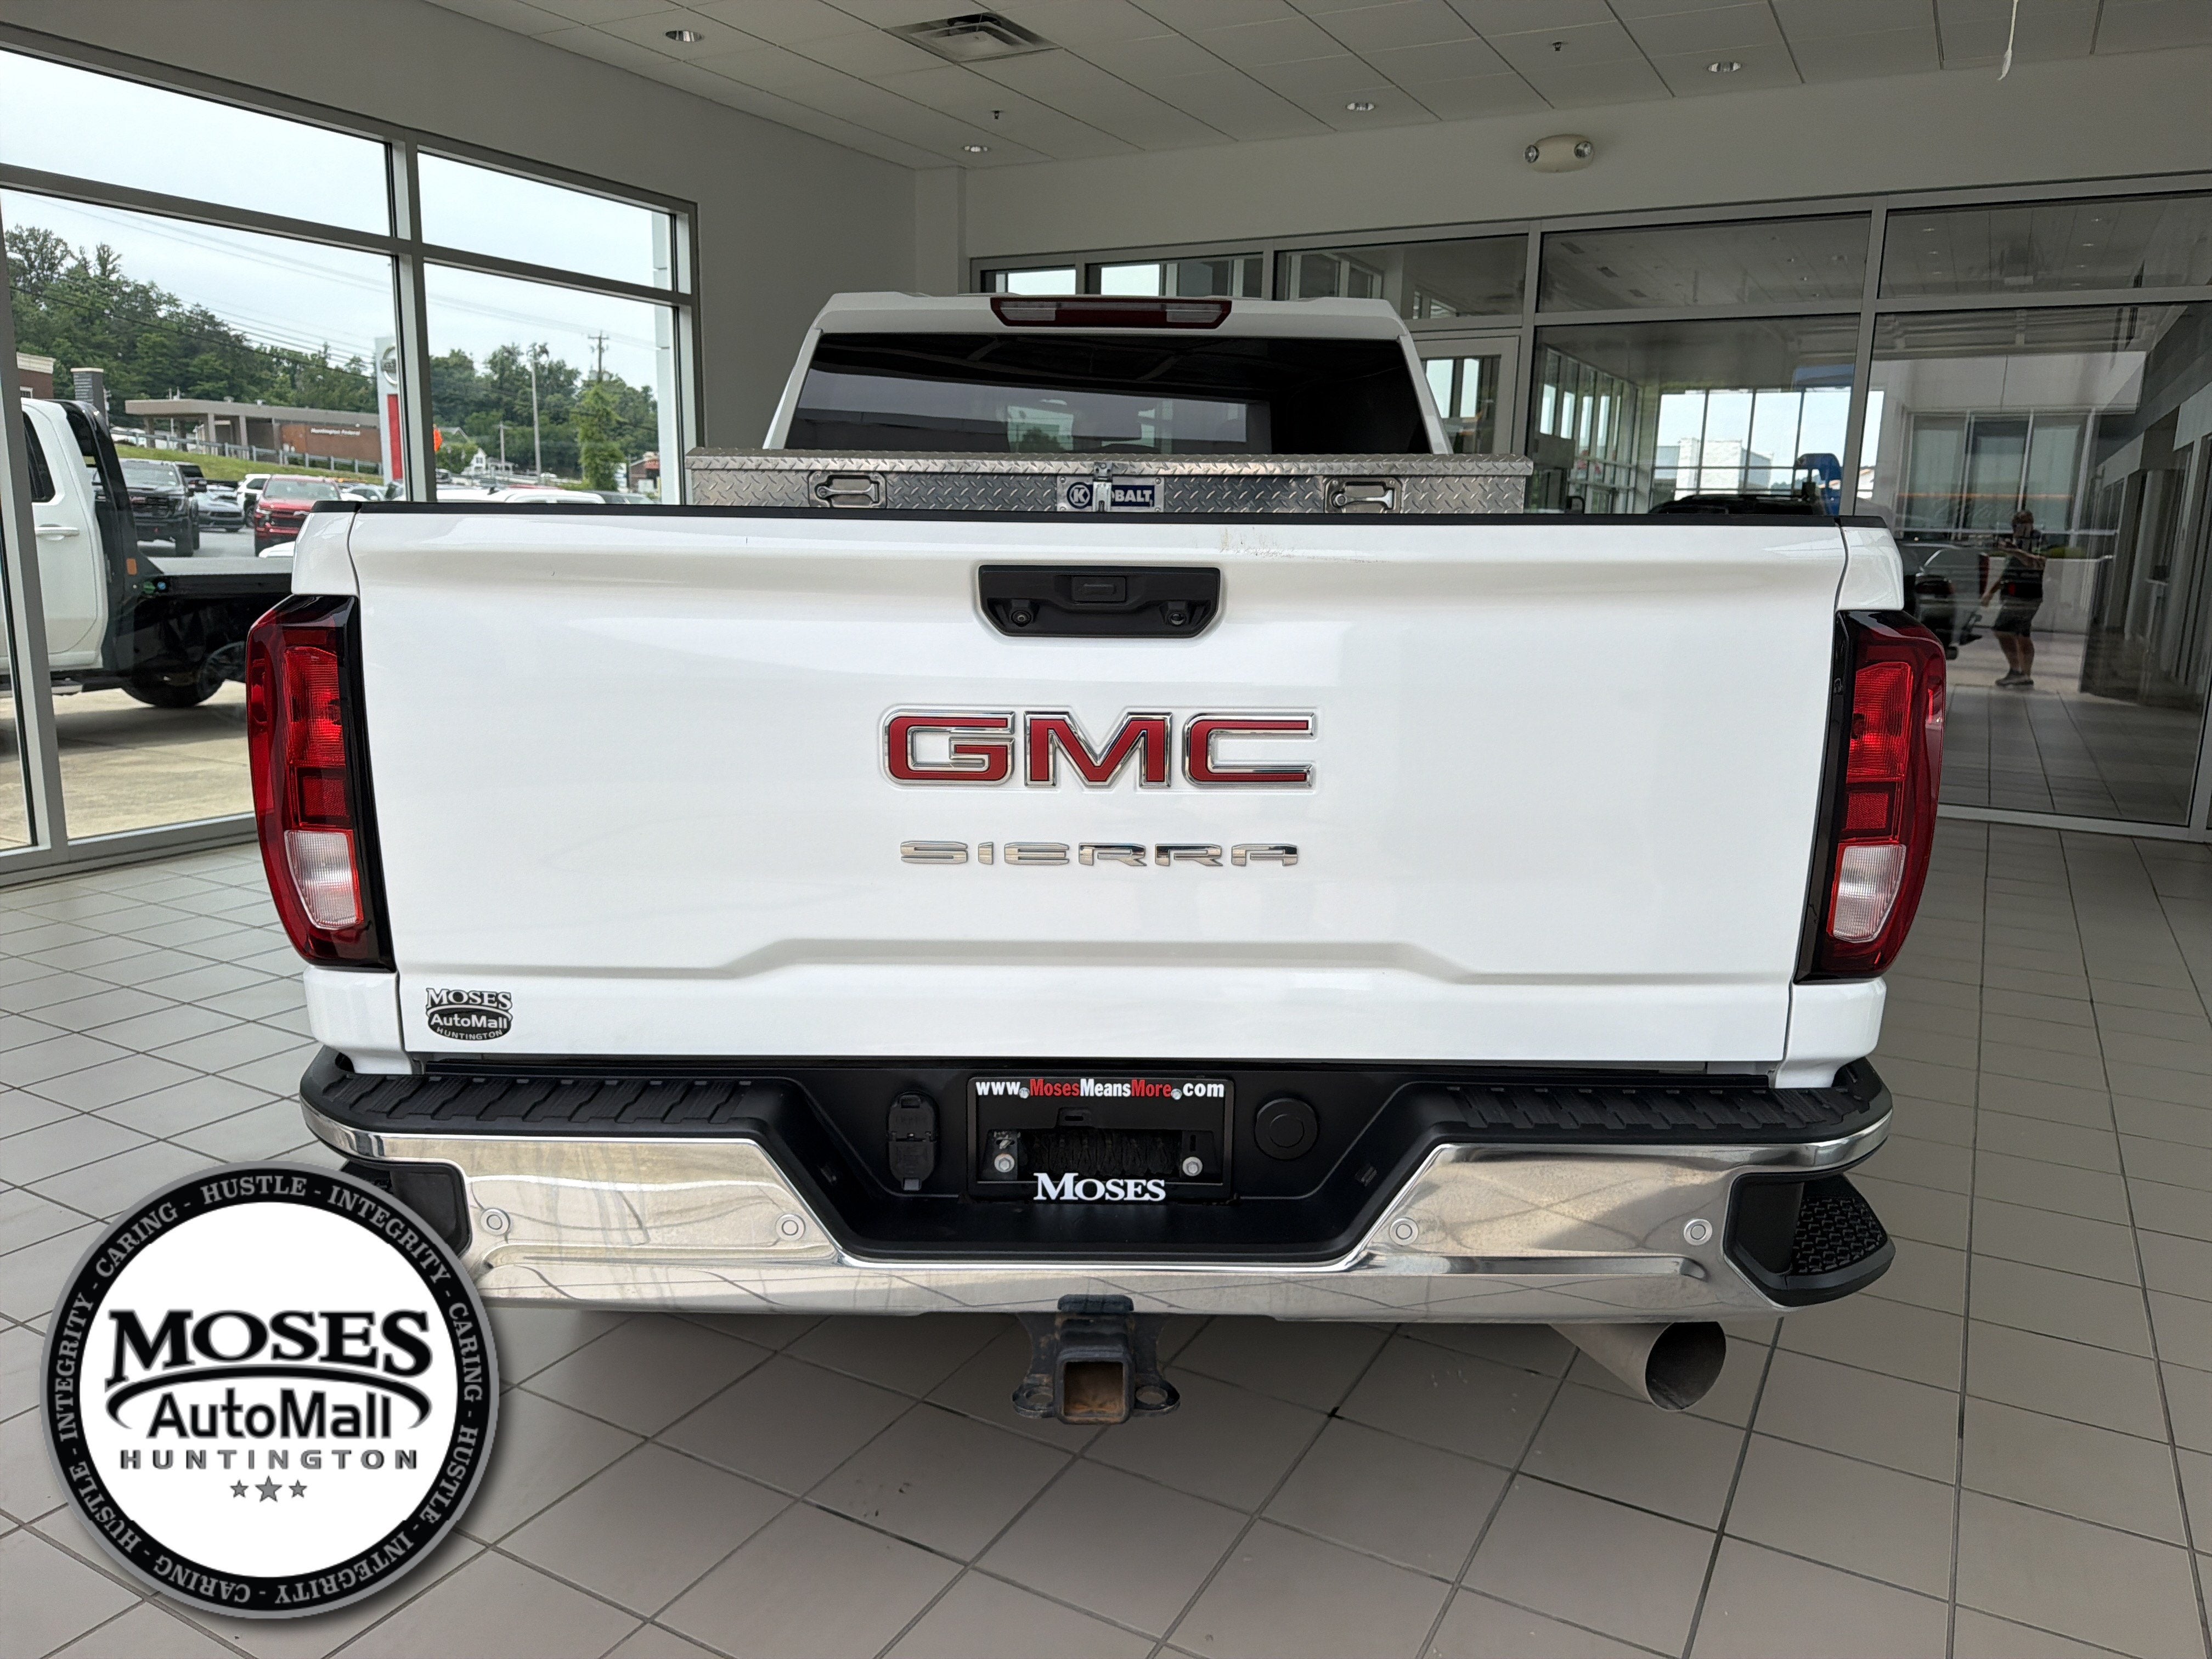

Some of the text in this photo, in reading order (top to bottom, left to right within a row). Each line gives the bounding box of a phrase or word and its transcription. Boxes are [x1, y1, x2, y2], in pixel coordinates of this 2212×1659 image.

[1071, 487, 1153, 503] KBALT
[882, 710, 1316, 788] GMC
[900, 840, 1299, 867] SIERRA
[426, 988, 512, 1010] MOSES
[430, 1013, 508, 1029] AutoMall
[436, 1026, 503, 1040] HUNTINGTON
[1033, 1172, 1166, 1201] MOSES
